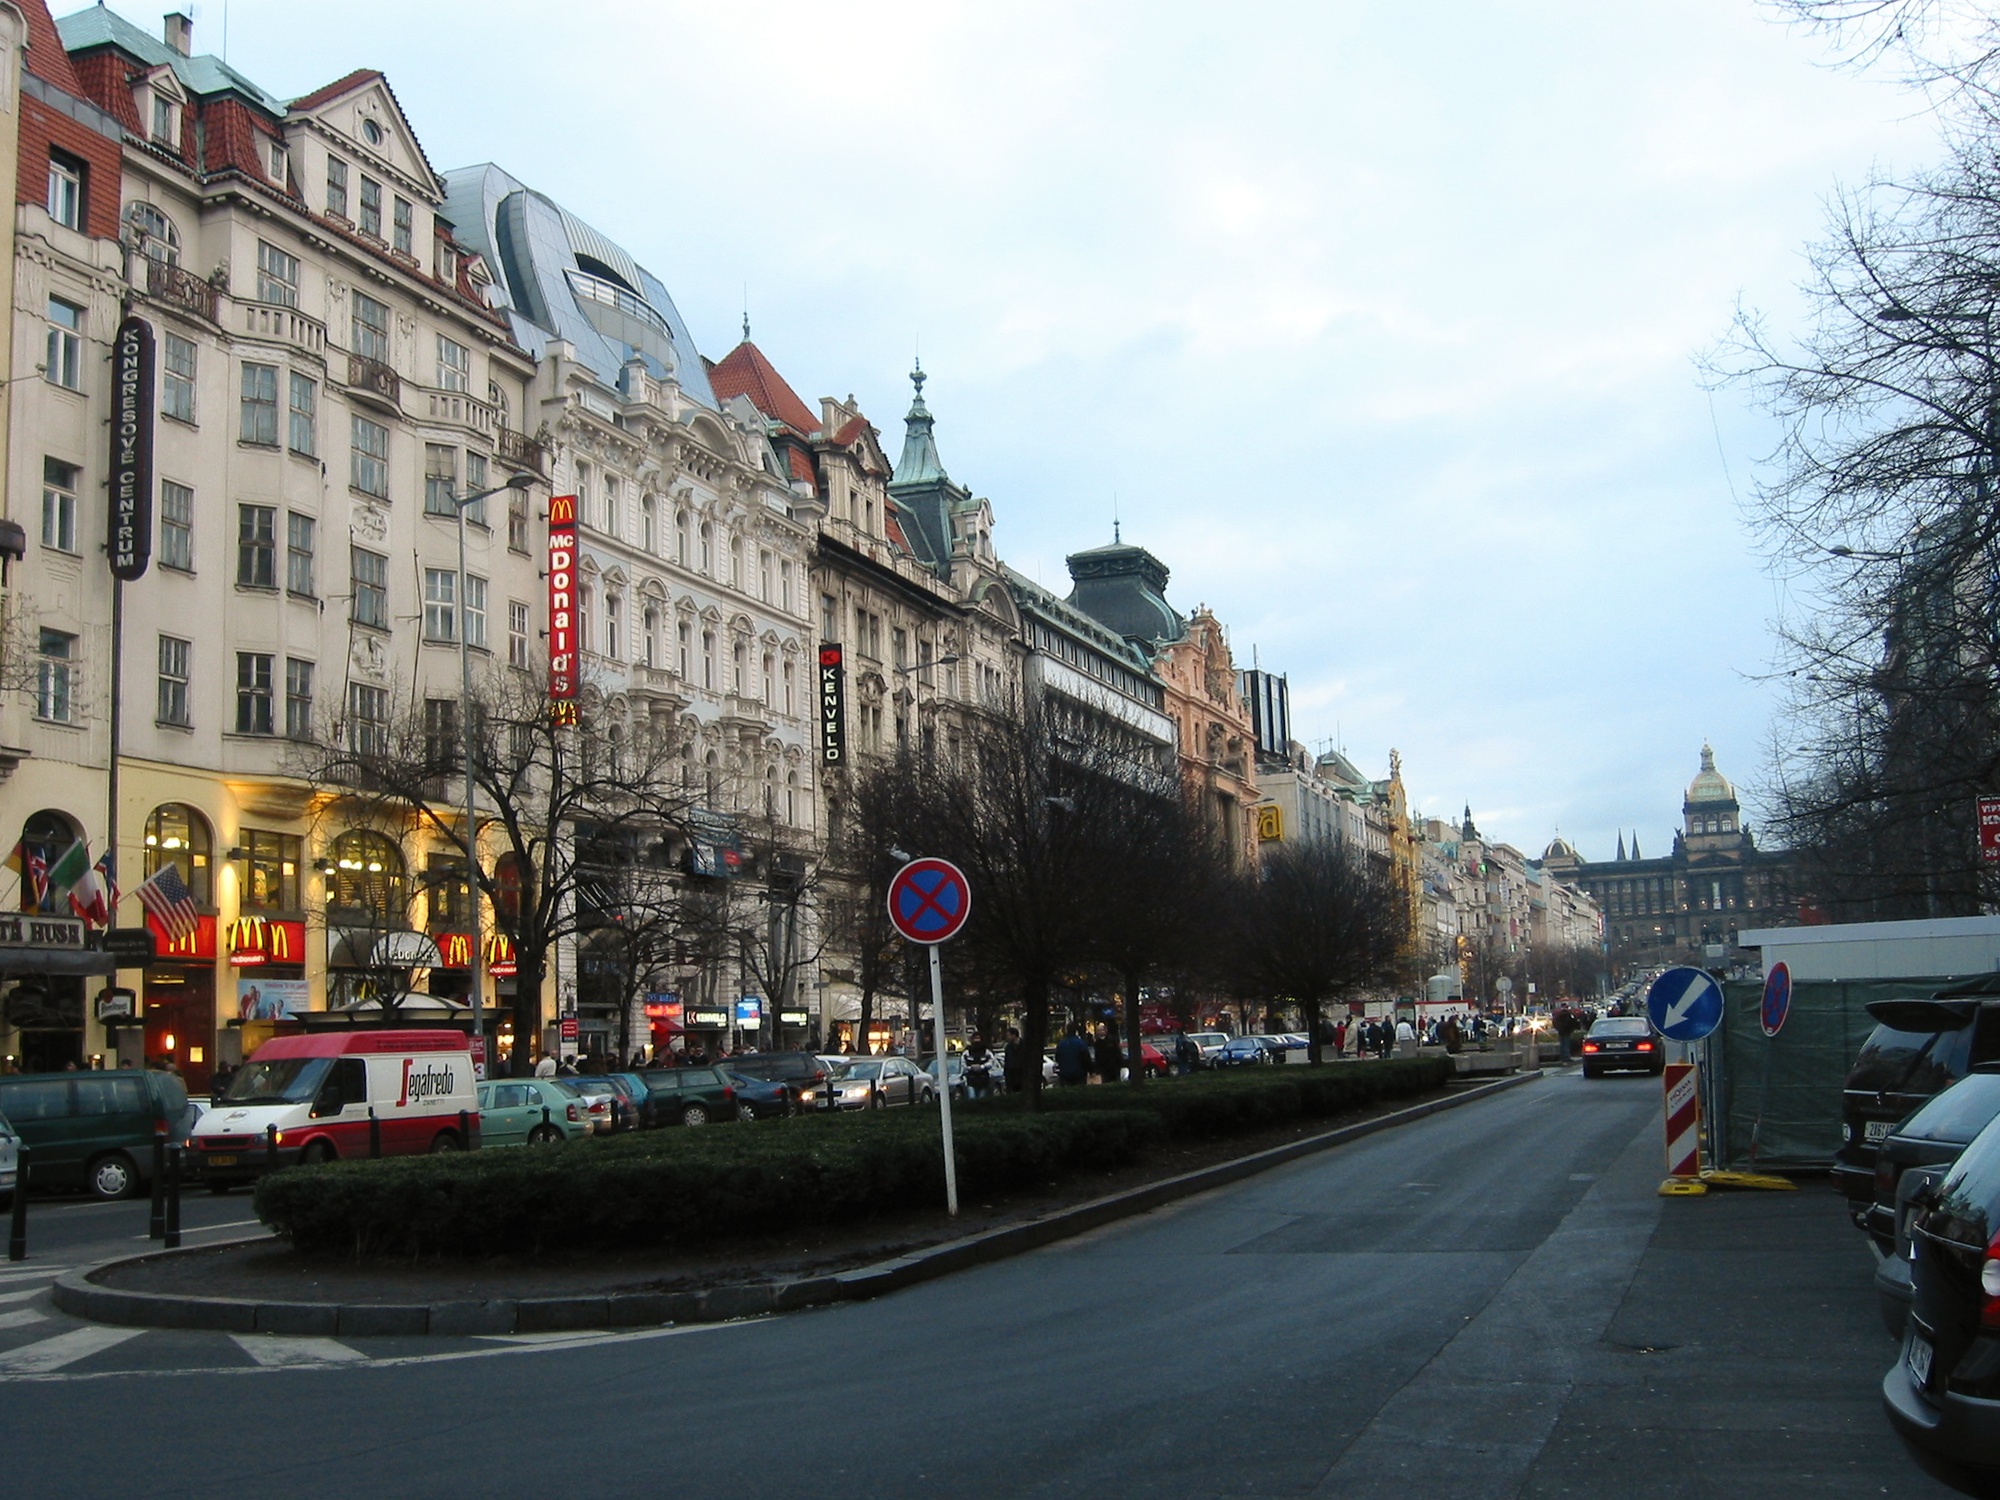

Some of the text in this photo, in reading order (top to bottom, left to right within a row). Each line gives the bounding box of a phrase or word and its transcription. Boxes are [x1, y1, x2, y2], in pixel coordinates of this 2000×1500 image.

[117, 471, 135, 567] CENTRUM
[823, 668, 839, 760] KENVELO
[30, 922, 80, 944] HUSA
[396, 1058, 454, 1107] Segafredo
